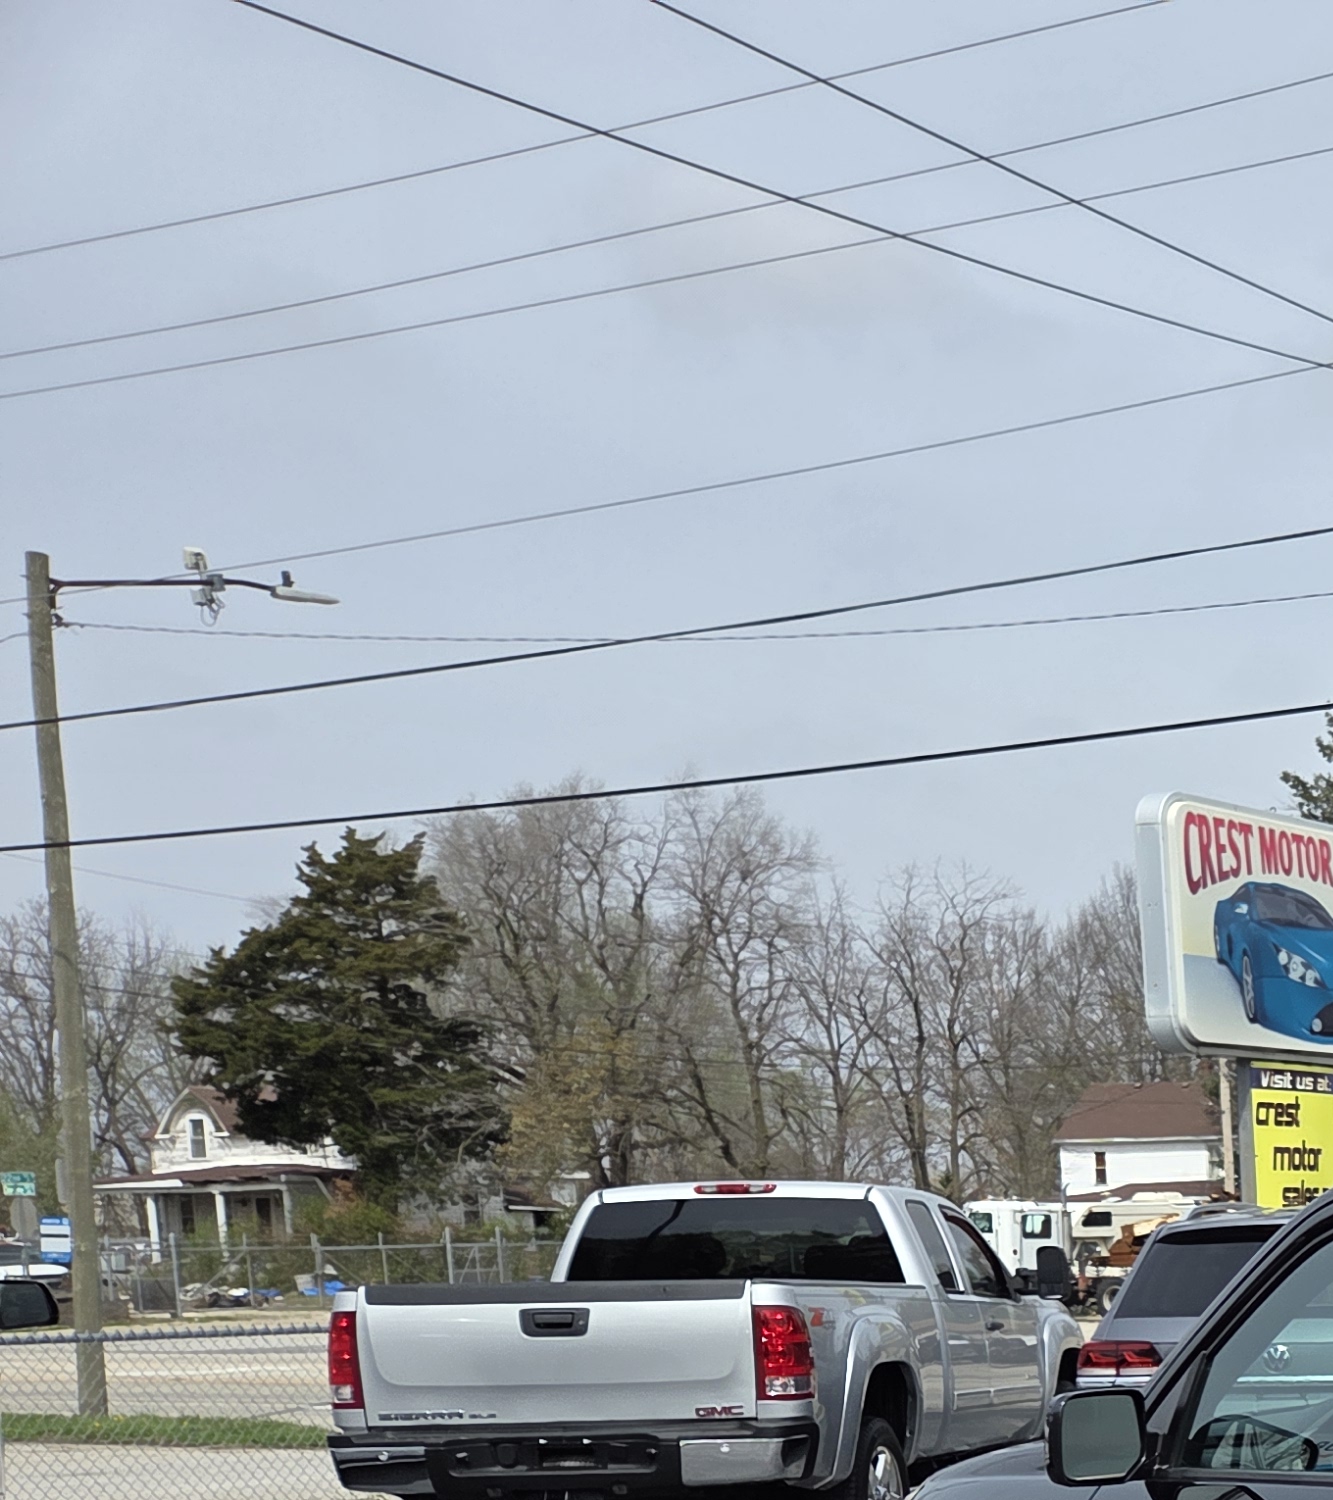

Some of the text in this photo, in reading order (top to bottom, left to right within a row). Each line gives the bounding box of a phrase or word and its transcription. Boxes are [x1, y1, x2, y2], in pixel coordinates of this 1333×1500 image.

[1184, 811, 1253, 895] CREST
[1261, 1070, 1292, 1089] Visit
[1296, 1076, 1314, 1090] us
[1256, 1096, 1300, 1128] crest
[1273, 1140, 1322, 1172] motor
[695, 1405, 744, 1417] GMC
